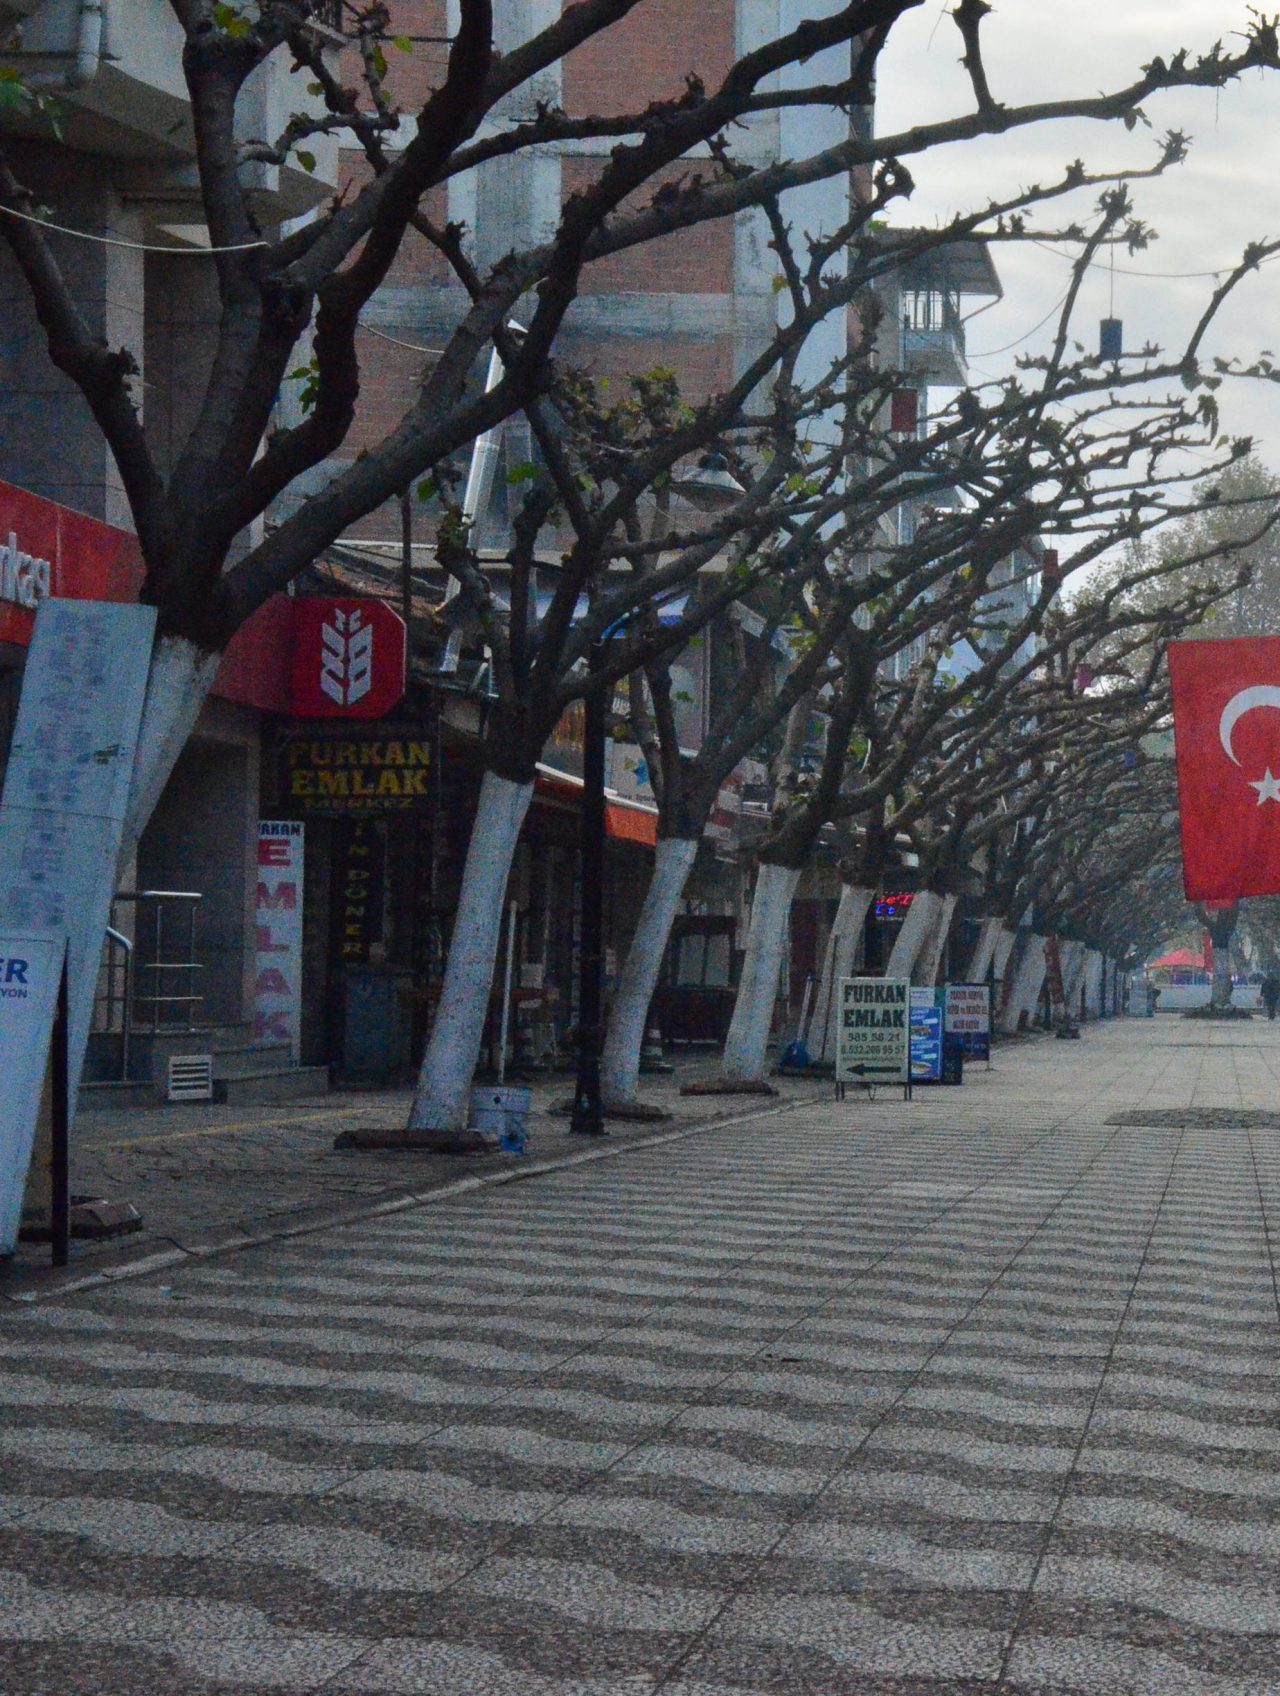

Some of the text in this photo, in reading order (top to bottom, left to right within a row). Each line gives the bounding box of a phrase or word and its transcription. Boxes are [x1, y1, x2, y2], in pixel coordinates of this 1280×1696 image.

[289, 742, 431, 765] FURKAN
[292, 769, 428, 795] EMLAK
[258, 823, 301, 836] RKAN
[255, 838, 297, 1039] EMLAK
[844, 984, 906, 1003] FURKAN
[844, 1009, 905, 1028] EMLAK
